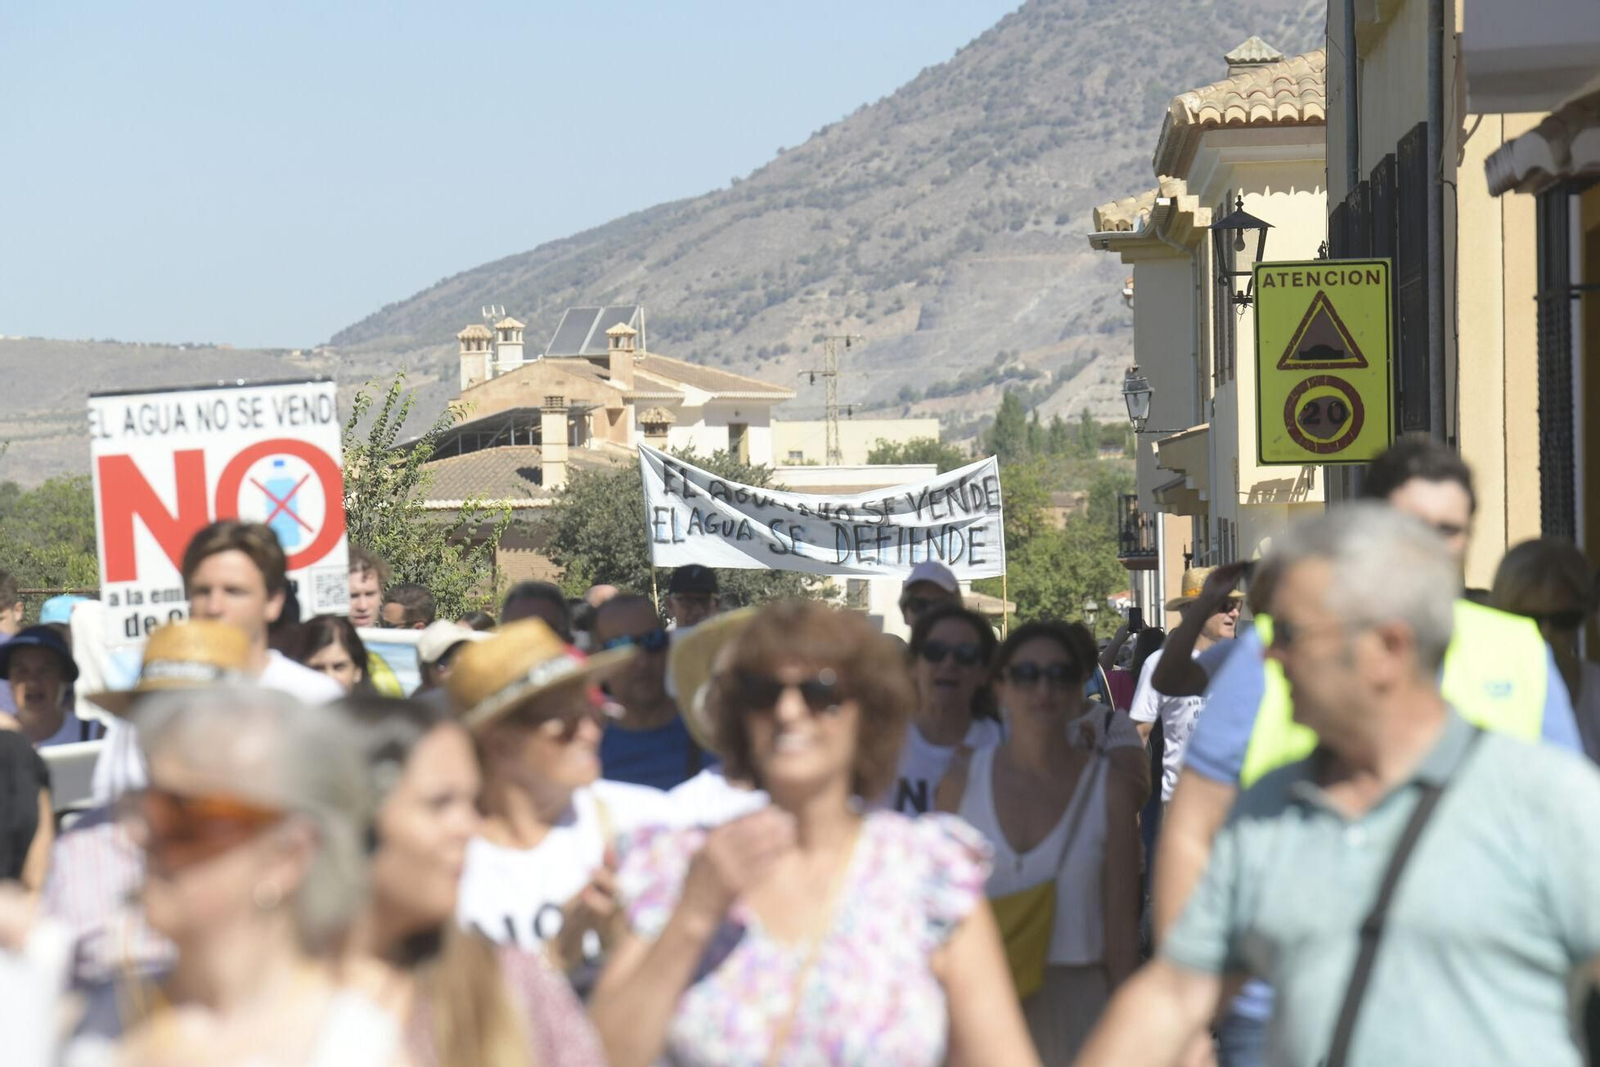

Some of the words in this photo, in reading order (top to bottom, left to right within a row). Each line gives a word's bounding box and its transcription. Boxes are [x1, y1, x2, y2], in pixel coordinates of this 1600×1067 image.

[1262, 269, 1381, 288] ATENCION
[123, 403, 188, 436] AGUA
[197, 399, 229, 431] NO
[238, 397, 264, 428] SE
[273, 393, 339, 426] VEND
[1303, 401, 1347, 425] 20
[98, 438, 347, 583] NO
[663, 460, 699, 499] EL
[905, 474, 1001, 521] VENDE
[653, 506, 685, 544] EL
[687, 507, 751, 541] AGUA
[831, 522, 988, 565] DEFIENDE
[109, 592, 119, 607] a
[126, 588, 143, 606] la
